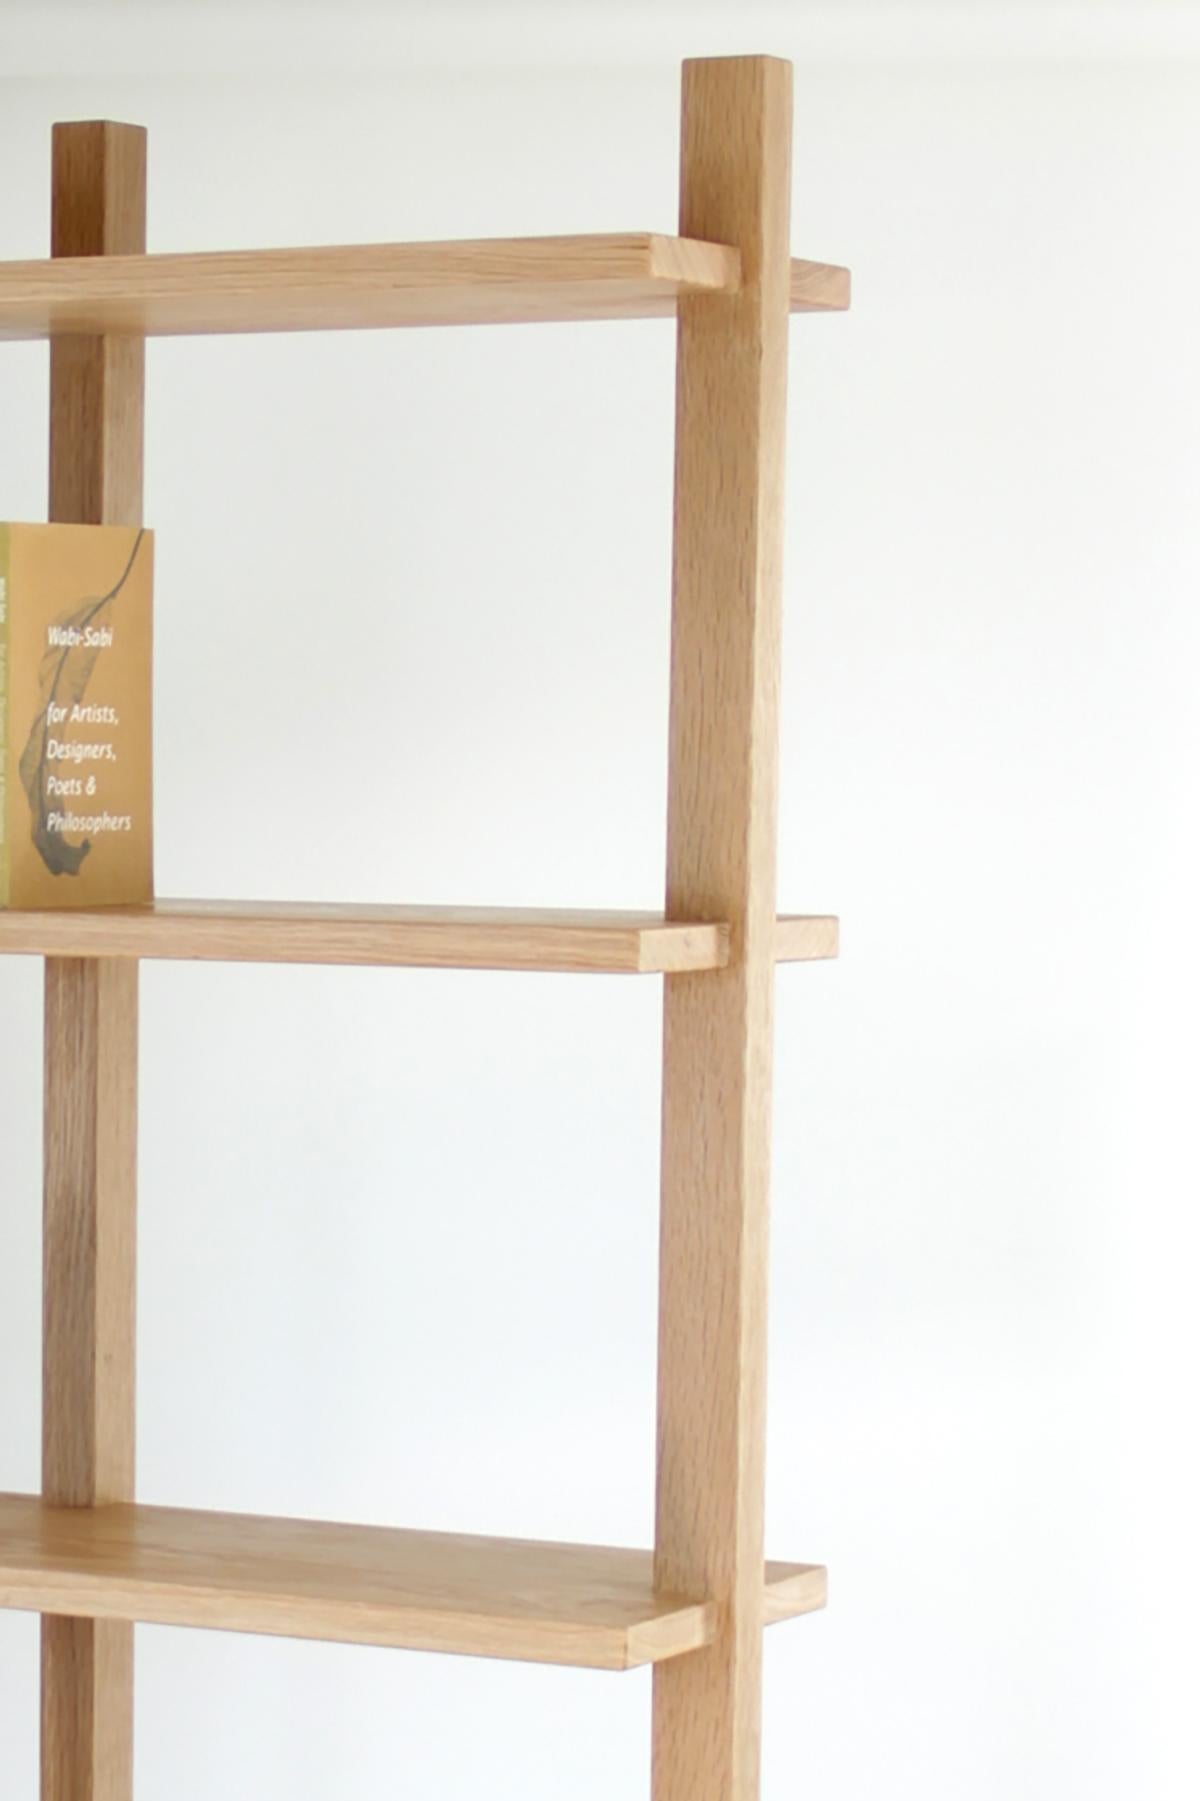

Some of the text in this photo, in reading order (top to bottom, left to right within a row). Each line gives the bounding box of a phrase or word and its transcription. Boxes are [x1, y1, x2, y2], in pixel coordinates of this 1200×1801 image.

[48, 626, 113, 647] Wabi-Sabi
[47, 702, 119, 726] for Artists,
[47, 739, 116, 763] Designers,
[47, 775, 96, 796] Poets &
[47, 811, 132, 834] Philosophers
